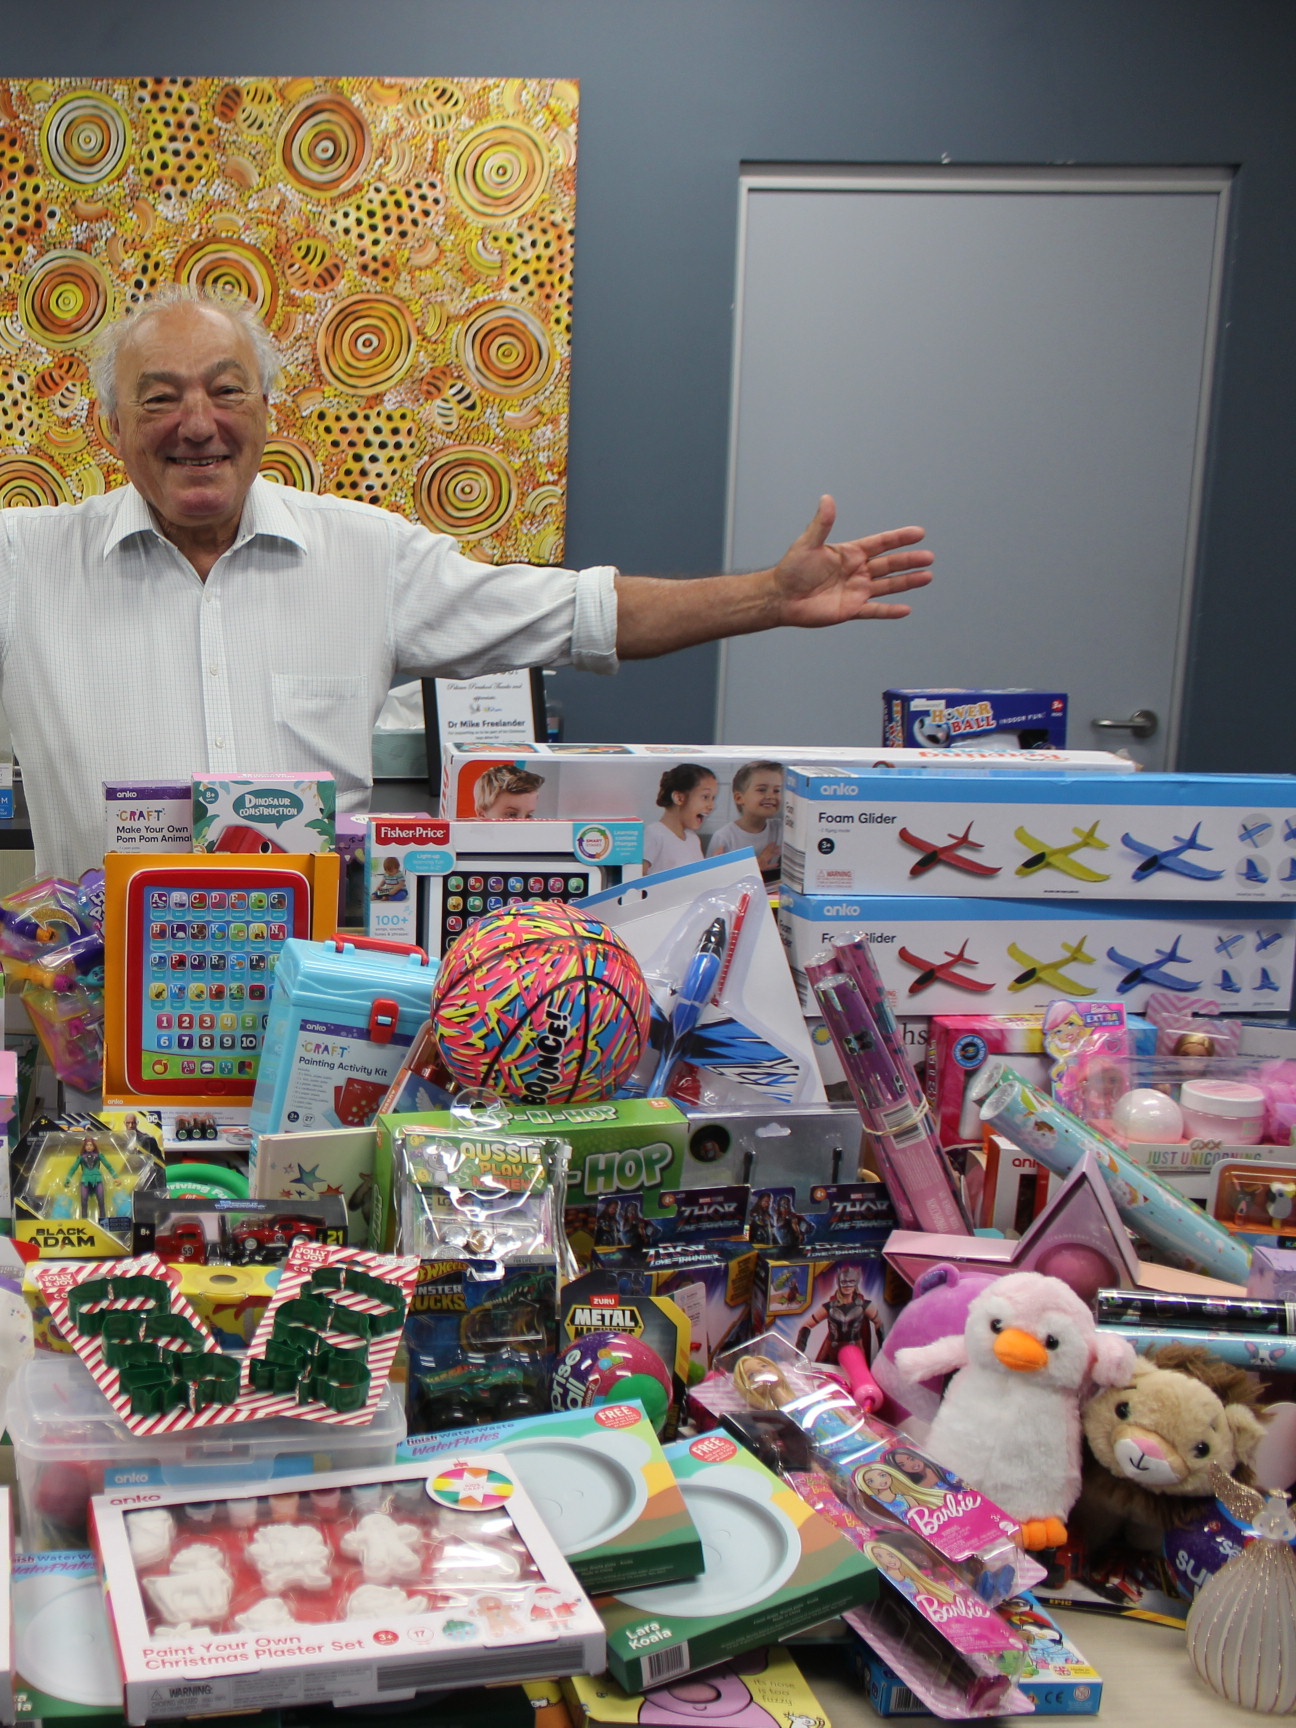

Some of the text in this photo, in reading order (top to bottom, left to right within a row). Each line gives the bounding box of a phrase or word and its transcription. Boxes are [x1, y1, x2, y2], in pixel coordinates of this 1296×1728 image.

[931, 701, 993, 725] HOVER
[460, 720, 481, 728] Mike
[482, 719, 526, 727] Freelander
[950, 715, 996, 733] BALL
[116, 790, 138, 798] anko
[819, 785, 859, 796] anko
[244, 793, 291, 808] DINOSAUR
[119, 809, 163, 822] CRAFT
[239, 806, 298, 817] CONSTRUCTION
[818, 812, 897, 825] Foam Glider
[116, 825, 189, 834] Make Your Own
[116, 835, 159, 844] Pom Pom
[823, 904, 861, 916] anko
[375, 914, 409, 927] 100+
[160, 1015, 253, 1028] 1 2 3 4 5
[305, 1022, 327, 1032] anko
[159, 1036, 256, 1048] 6 7 8 9 10
[304, 1040, 347, 1059] CRAFT
[520, 1008, 571, 1104] BOUNCE!
[298, 1056, 388, 1077] Painting Activity Kit
[146, 1114, 159, 1124] DC
[459, 1141, 543, 1165] AUSSIE
[1145, 1151, 1178, 1165] JUST
[478, 1161, 524, 1176] PLAY
[35, 1227, 79, 1237] BLACK
[326, 1230, 344, 1245] 21
[27, 1235, 96, 1248] ADAM
[182, 1246, 194, 1256] 59
[296, 1247, 329, 1257] JOLLY
[305, 1254, 325, 1263] JOY
[42, 1273, 74, 1283] JOLLY
[54, 1279, 73, 1288] JOY
[574, 1308, 635, 1327] METAL
[597, 1406, 633, 1421] FREE
[411, 1431, 501, 1457] WaterPlates
[691, 1437, 726, 1457] FREE
[114, 1472, 149, 1484] anko
[110, 1494, 162, 1506] anko
[906, 1493, 983, 1536] Barbie
[915, 1593, 991, 1623] Barbie
[625, 1621, 660, 1641] Lara
[627, 1628, 674, 1650] Koala
[142, 1634, 302, 1660] Paint Your Own
[144, 1639, 366, 1671] Christmas Plaster Set
[168, 1685, 213, 1699] WARNING:
